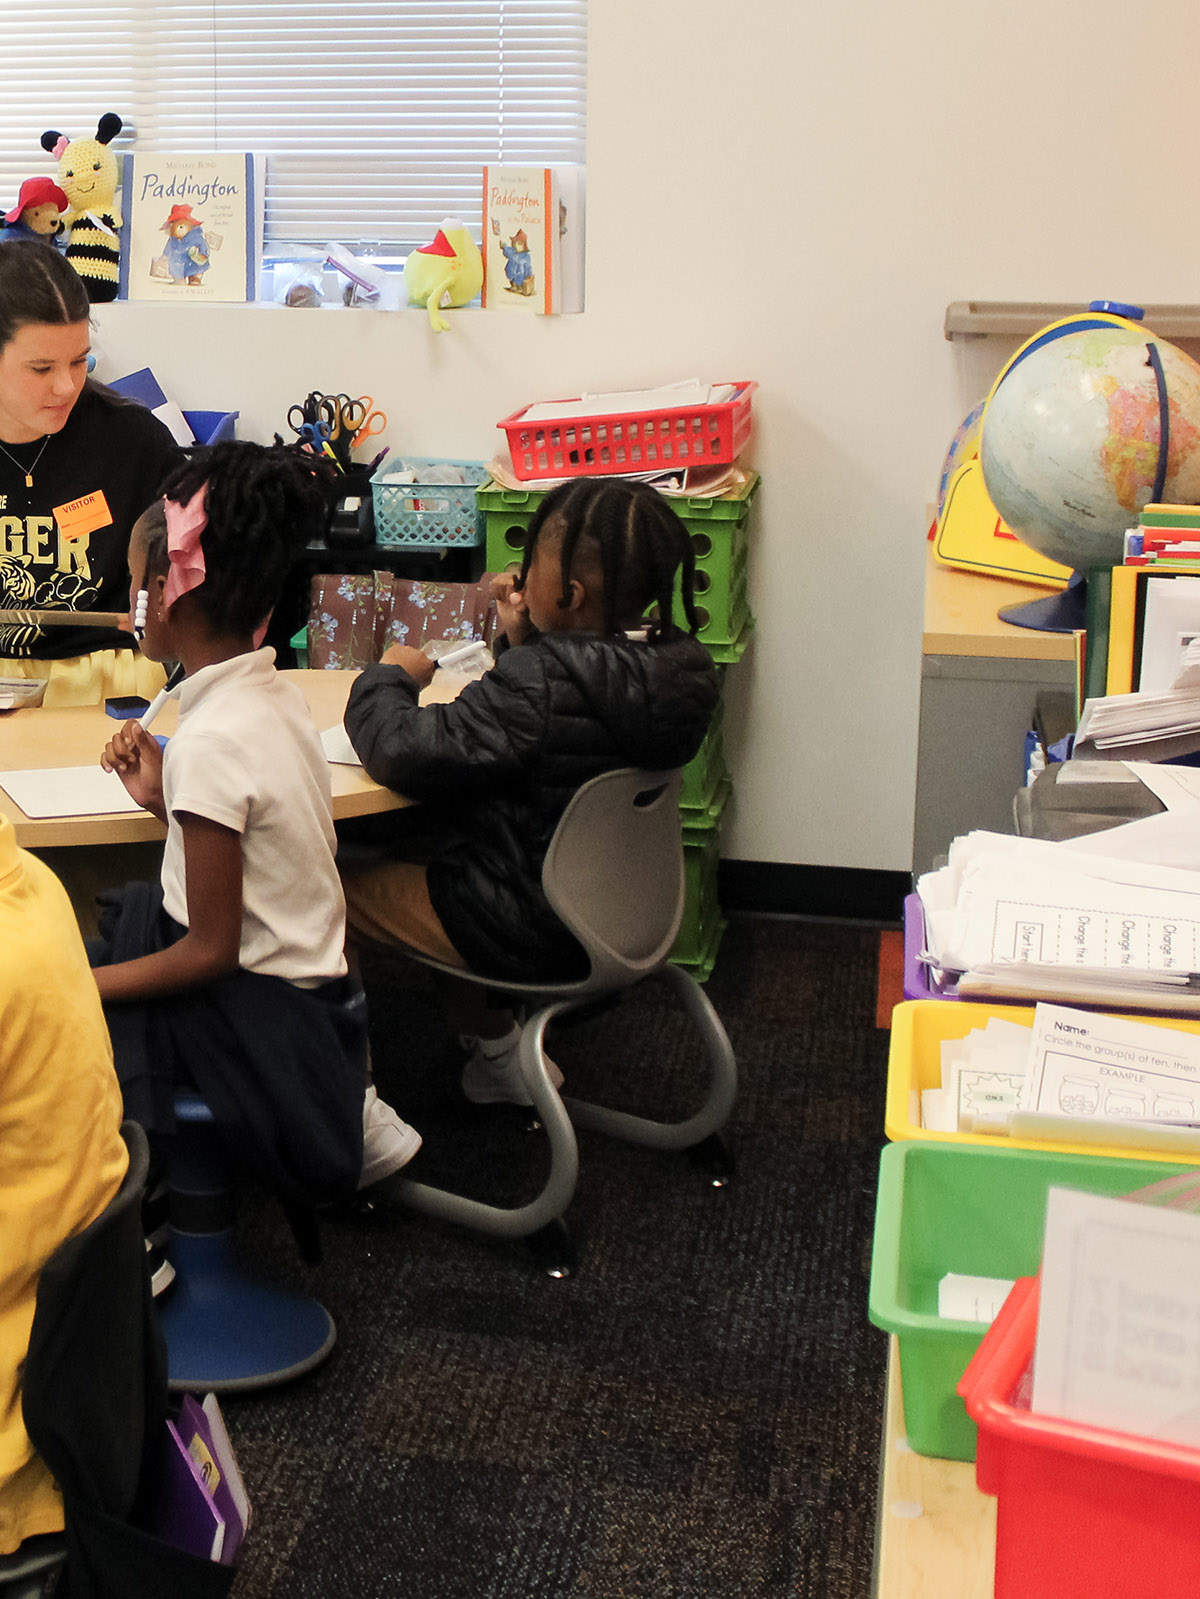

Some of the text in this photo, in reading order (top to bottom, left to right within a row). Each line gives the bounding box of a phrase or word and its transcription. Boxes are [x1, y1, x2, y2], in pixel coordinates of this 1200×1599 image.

[141, 173, 239, 205] Paddington
[491, 187, 540, 213] Paddington
[62, 495, 96, 514] VISITOR
[1022, 925, 1036, 946] Start
[1074, 916, 1091, 944] Change
[1118, 920, 1135, 965] Change the
[1076, 947, 1088, 958] the
[1159, 924, 1177, 968] Change the
[1044, 1034, 1073, 1047] Circle
[1075, 1040, 1092, 1051] the
[1094, 1045, 1136, 1062] group(s)
[1138, 1053, 1149, 1063] of
[1173, 1060, 1197, 1072] then
[1099, 1066, 1145, 1084] EXAMPLE
